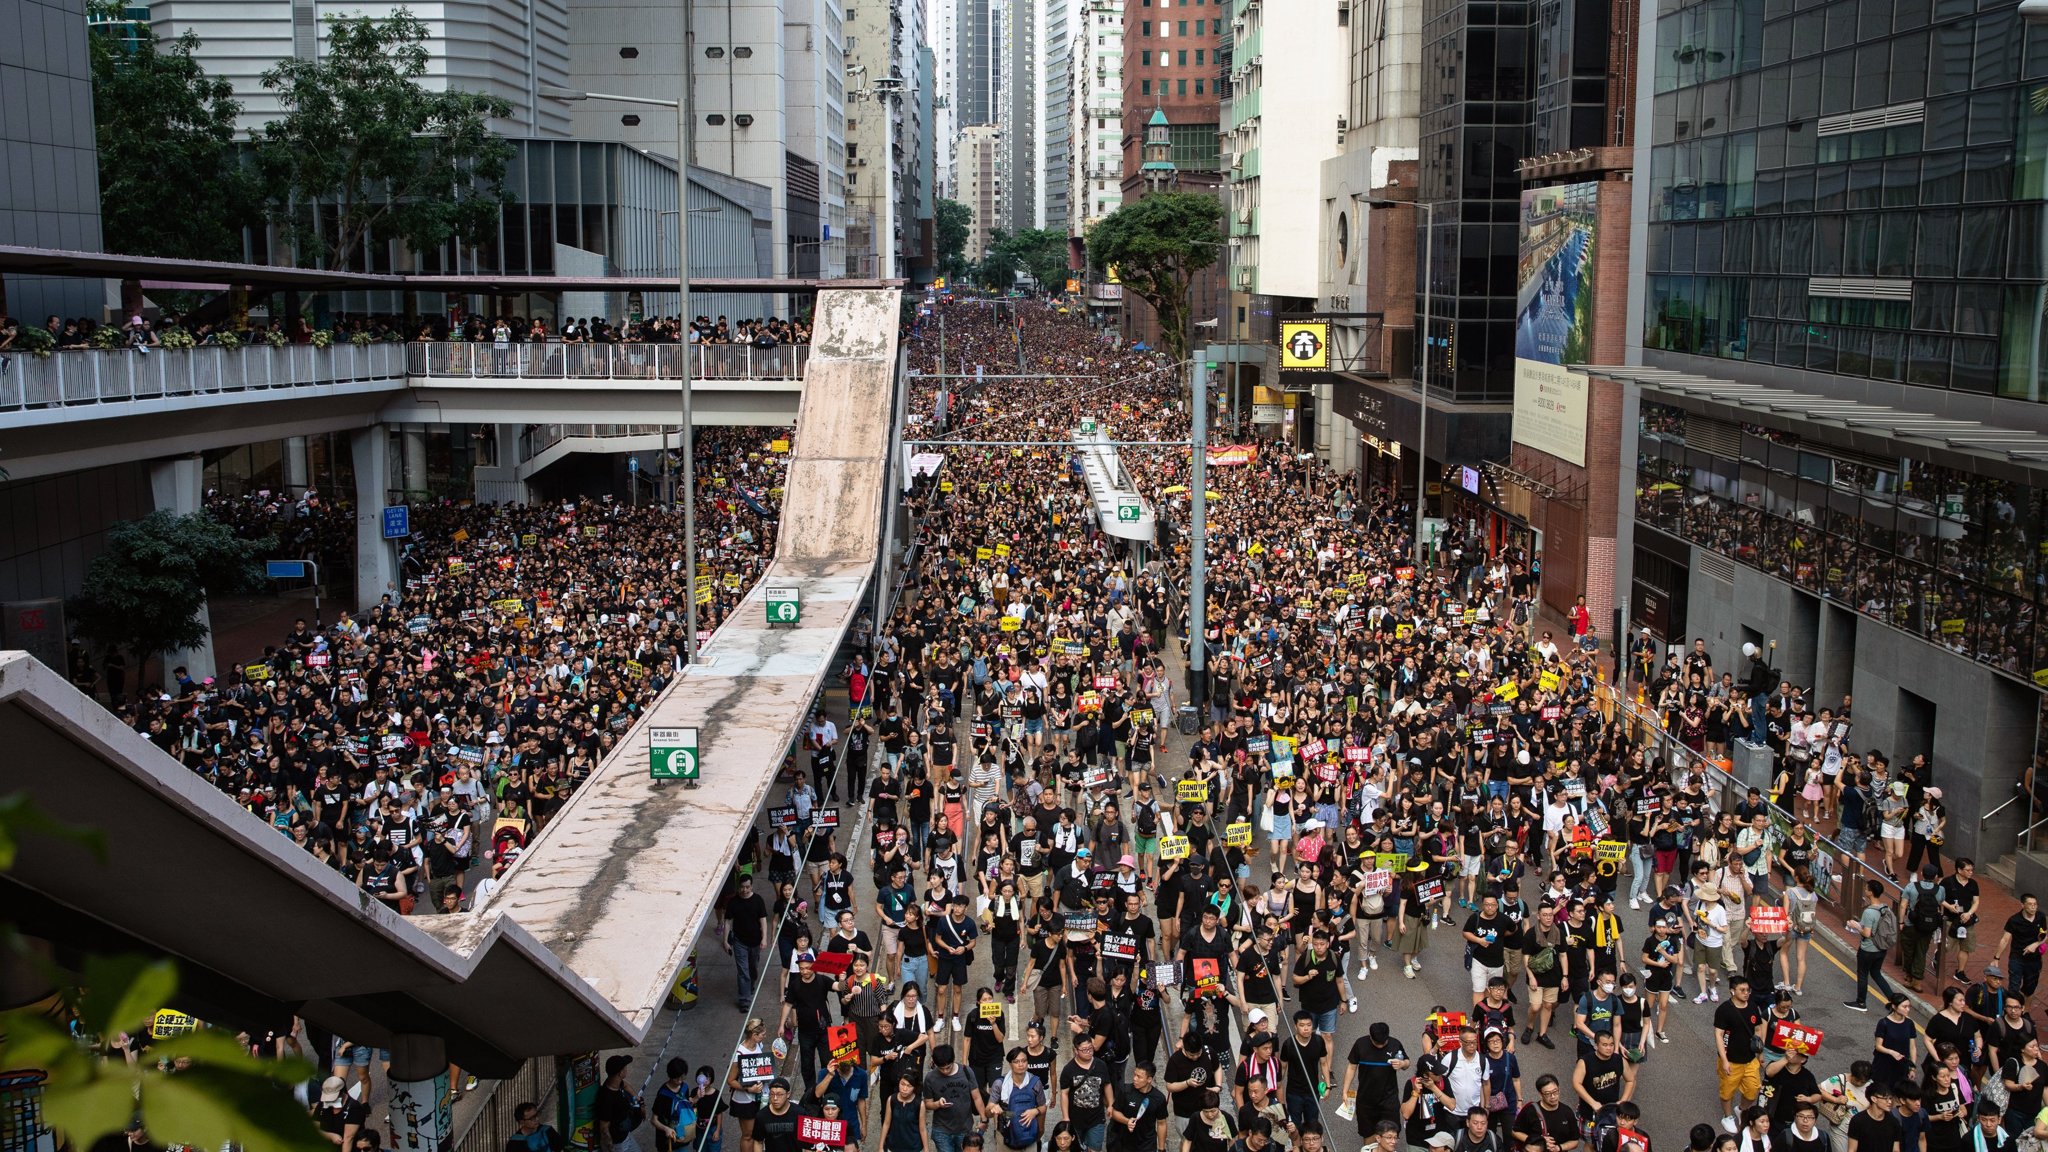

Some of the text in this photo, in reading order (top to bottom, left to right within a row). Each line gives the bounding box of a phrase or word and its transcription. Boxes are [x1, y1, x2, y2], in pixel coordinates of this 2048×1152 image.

[1228, 826, 1244, 835] STAND
[1162, 840, 1180, 848] STAND
[1367, 879, 1388, 888] 相信人民
[1418, 880, 1440, 892] 獨立調查
[1104, 935, 1136, 946] 獨立調查
[1197, 976, 1219, 987] 林鄭下台
[157, 1014, 196, 1025] 企硬立場
[1778, 1025, 1818, 1045] 賣港賊
[833, 1042, 857, 1057] 林鄭下台
[741, 1057, 771, 1067] 獨立調查
[743, 1066, 773, 1077] 警察鎮壓
[804, 1118, 842, 1132] 全面撤回
[803, 1126, 840, 1141] 送中惡法
